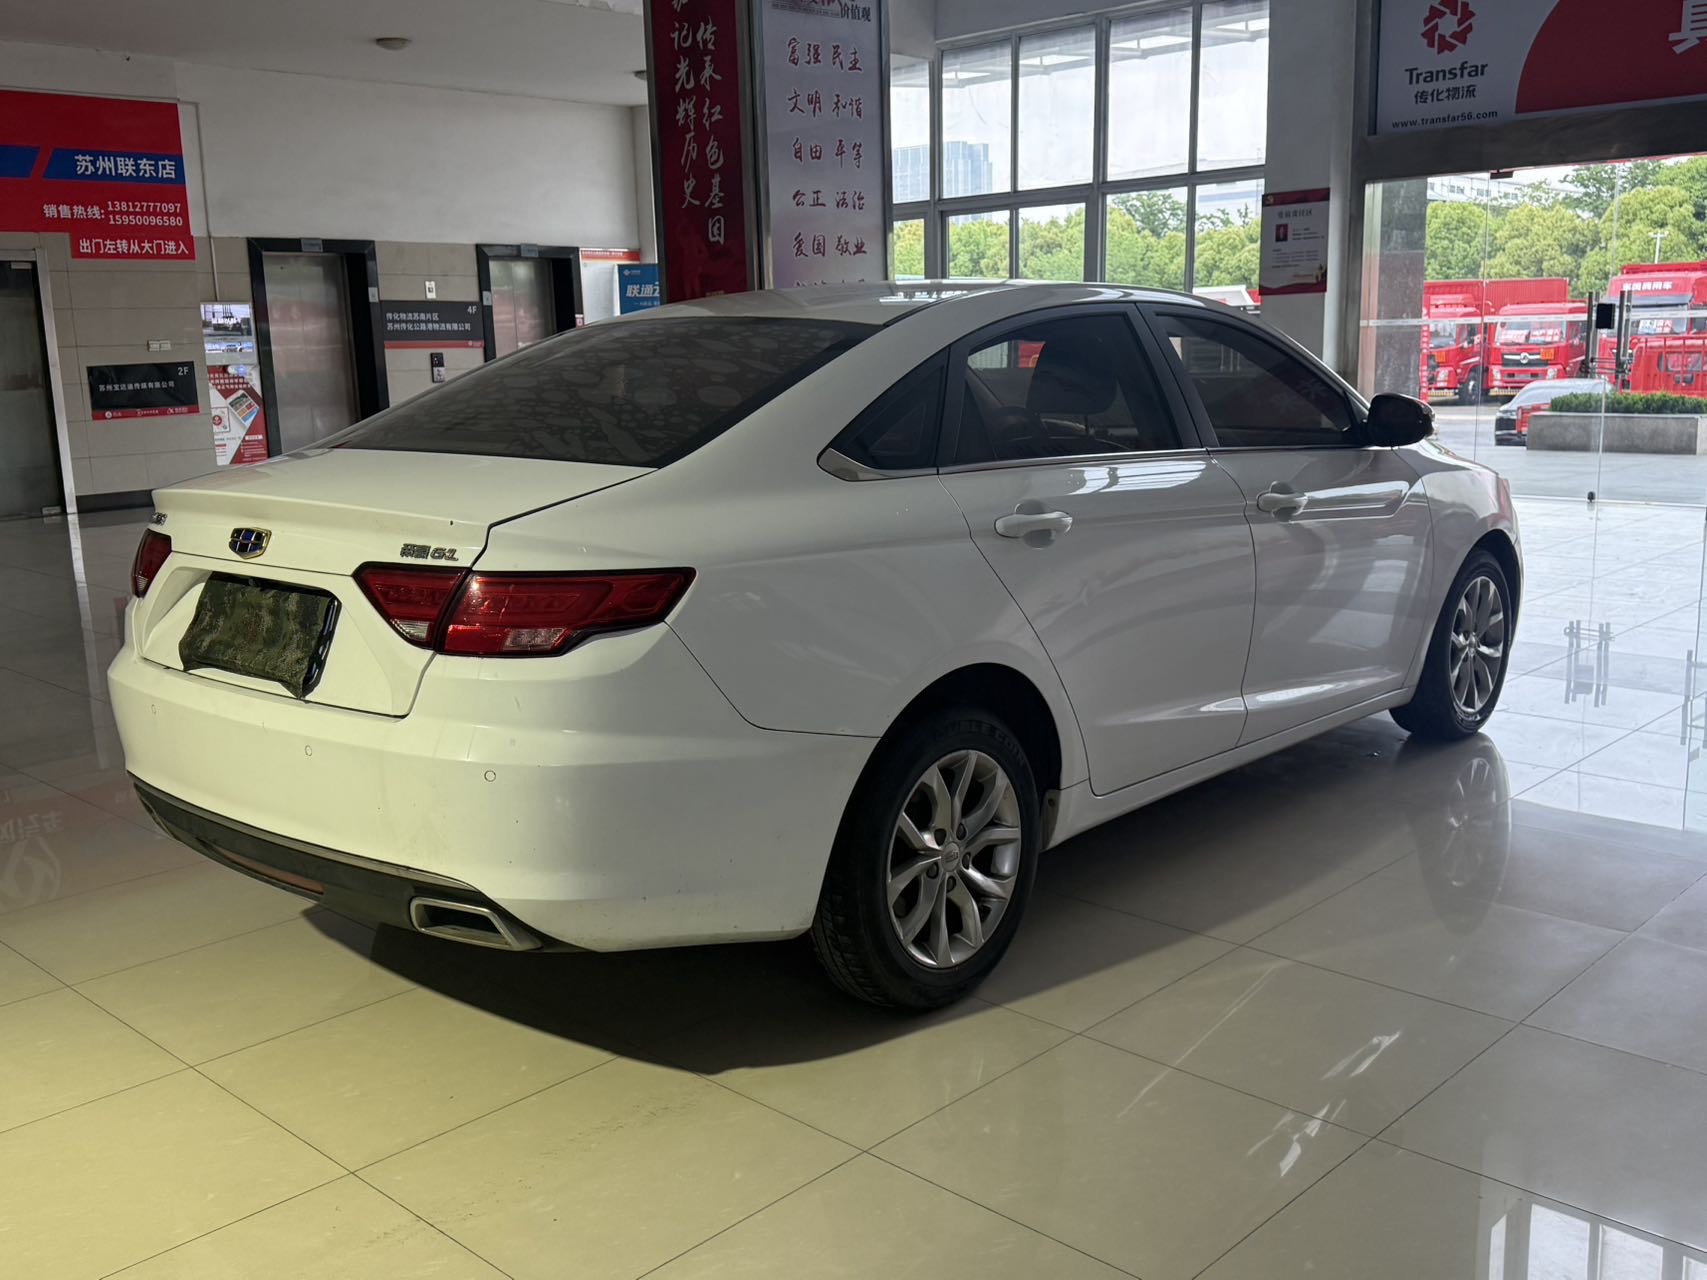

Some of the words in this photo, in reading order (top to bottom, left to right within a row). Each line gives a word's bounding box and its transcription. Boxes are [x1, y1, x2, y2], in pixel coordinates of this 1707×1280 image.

[787, 37, 822, 66] 富强
[832, 44, 863, 72] 民主
[1405, 61, 1488, 86] Transfar
[670, 0, 700, 208] 记光辉历史
[788, 88, 822, 118] 文明
[832, 94, 863, 119] 和谐
[1414, 84, 1477, 104] 传化物流
[1392, 110, 1498, 129] www.transfar56.com
[792, 138, 822, 163] 自由
[835, 139, 863, 169] 平等
[74, 154, 176, 179] 苏州联东店
[43, 203, 105, 220] 销售热线:
[107, 200, 181, 213] 13812777097
[792, 189, 826, 208] 公正
[836, 191, 865, 210] 法治
[109, 214, 183, 227] 15950096580
[79, 238, 189, 255] 出门左转从大门进入
[792, 231, 826, 258] 爱国
[835, 234, 867, 256] 敬业
[467, 305, 477, 314] 4F
[177, 366, 189, 376] 2F
